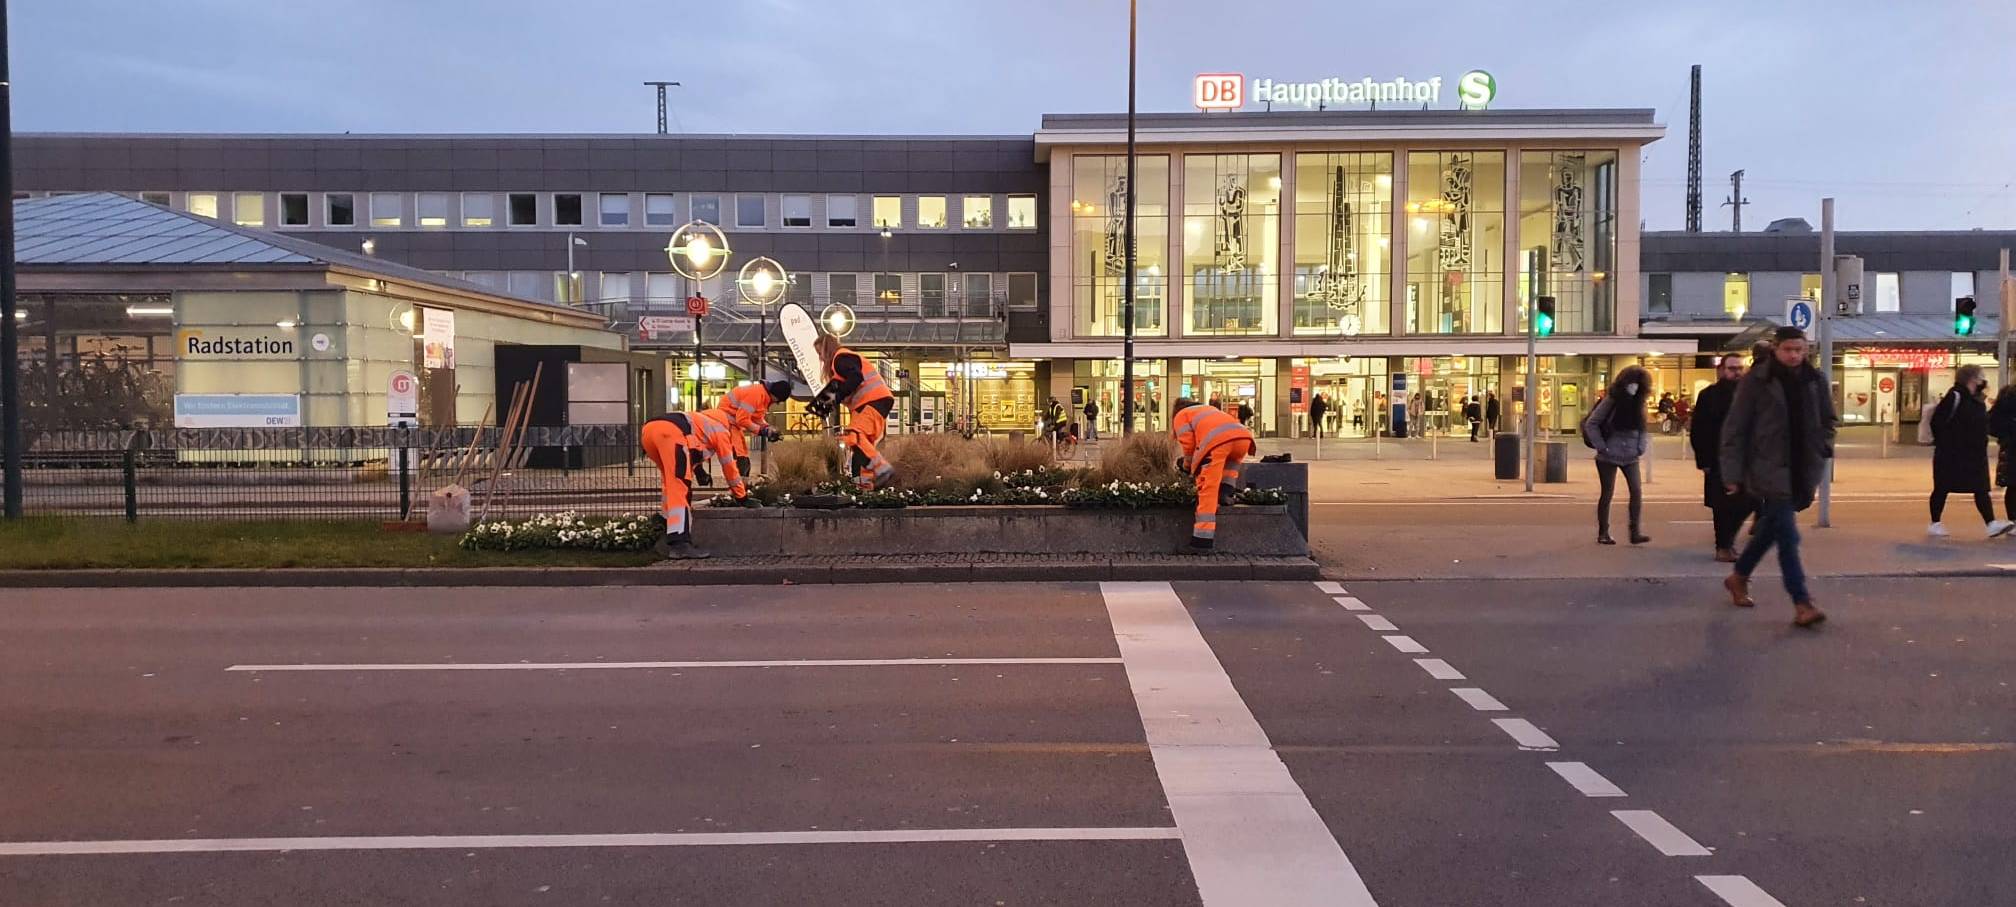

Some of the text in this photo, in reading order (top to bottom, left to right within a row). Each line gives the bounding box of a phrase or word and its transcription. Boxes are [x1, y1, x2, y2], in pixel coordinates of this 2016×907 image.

[1202, 73, 1491, 107] DB Hauptbahnhof S
[188, 336, 293, 354] Radstation
